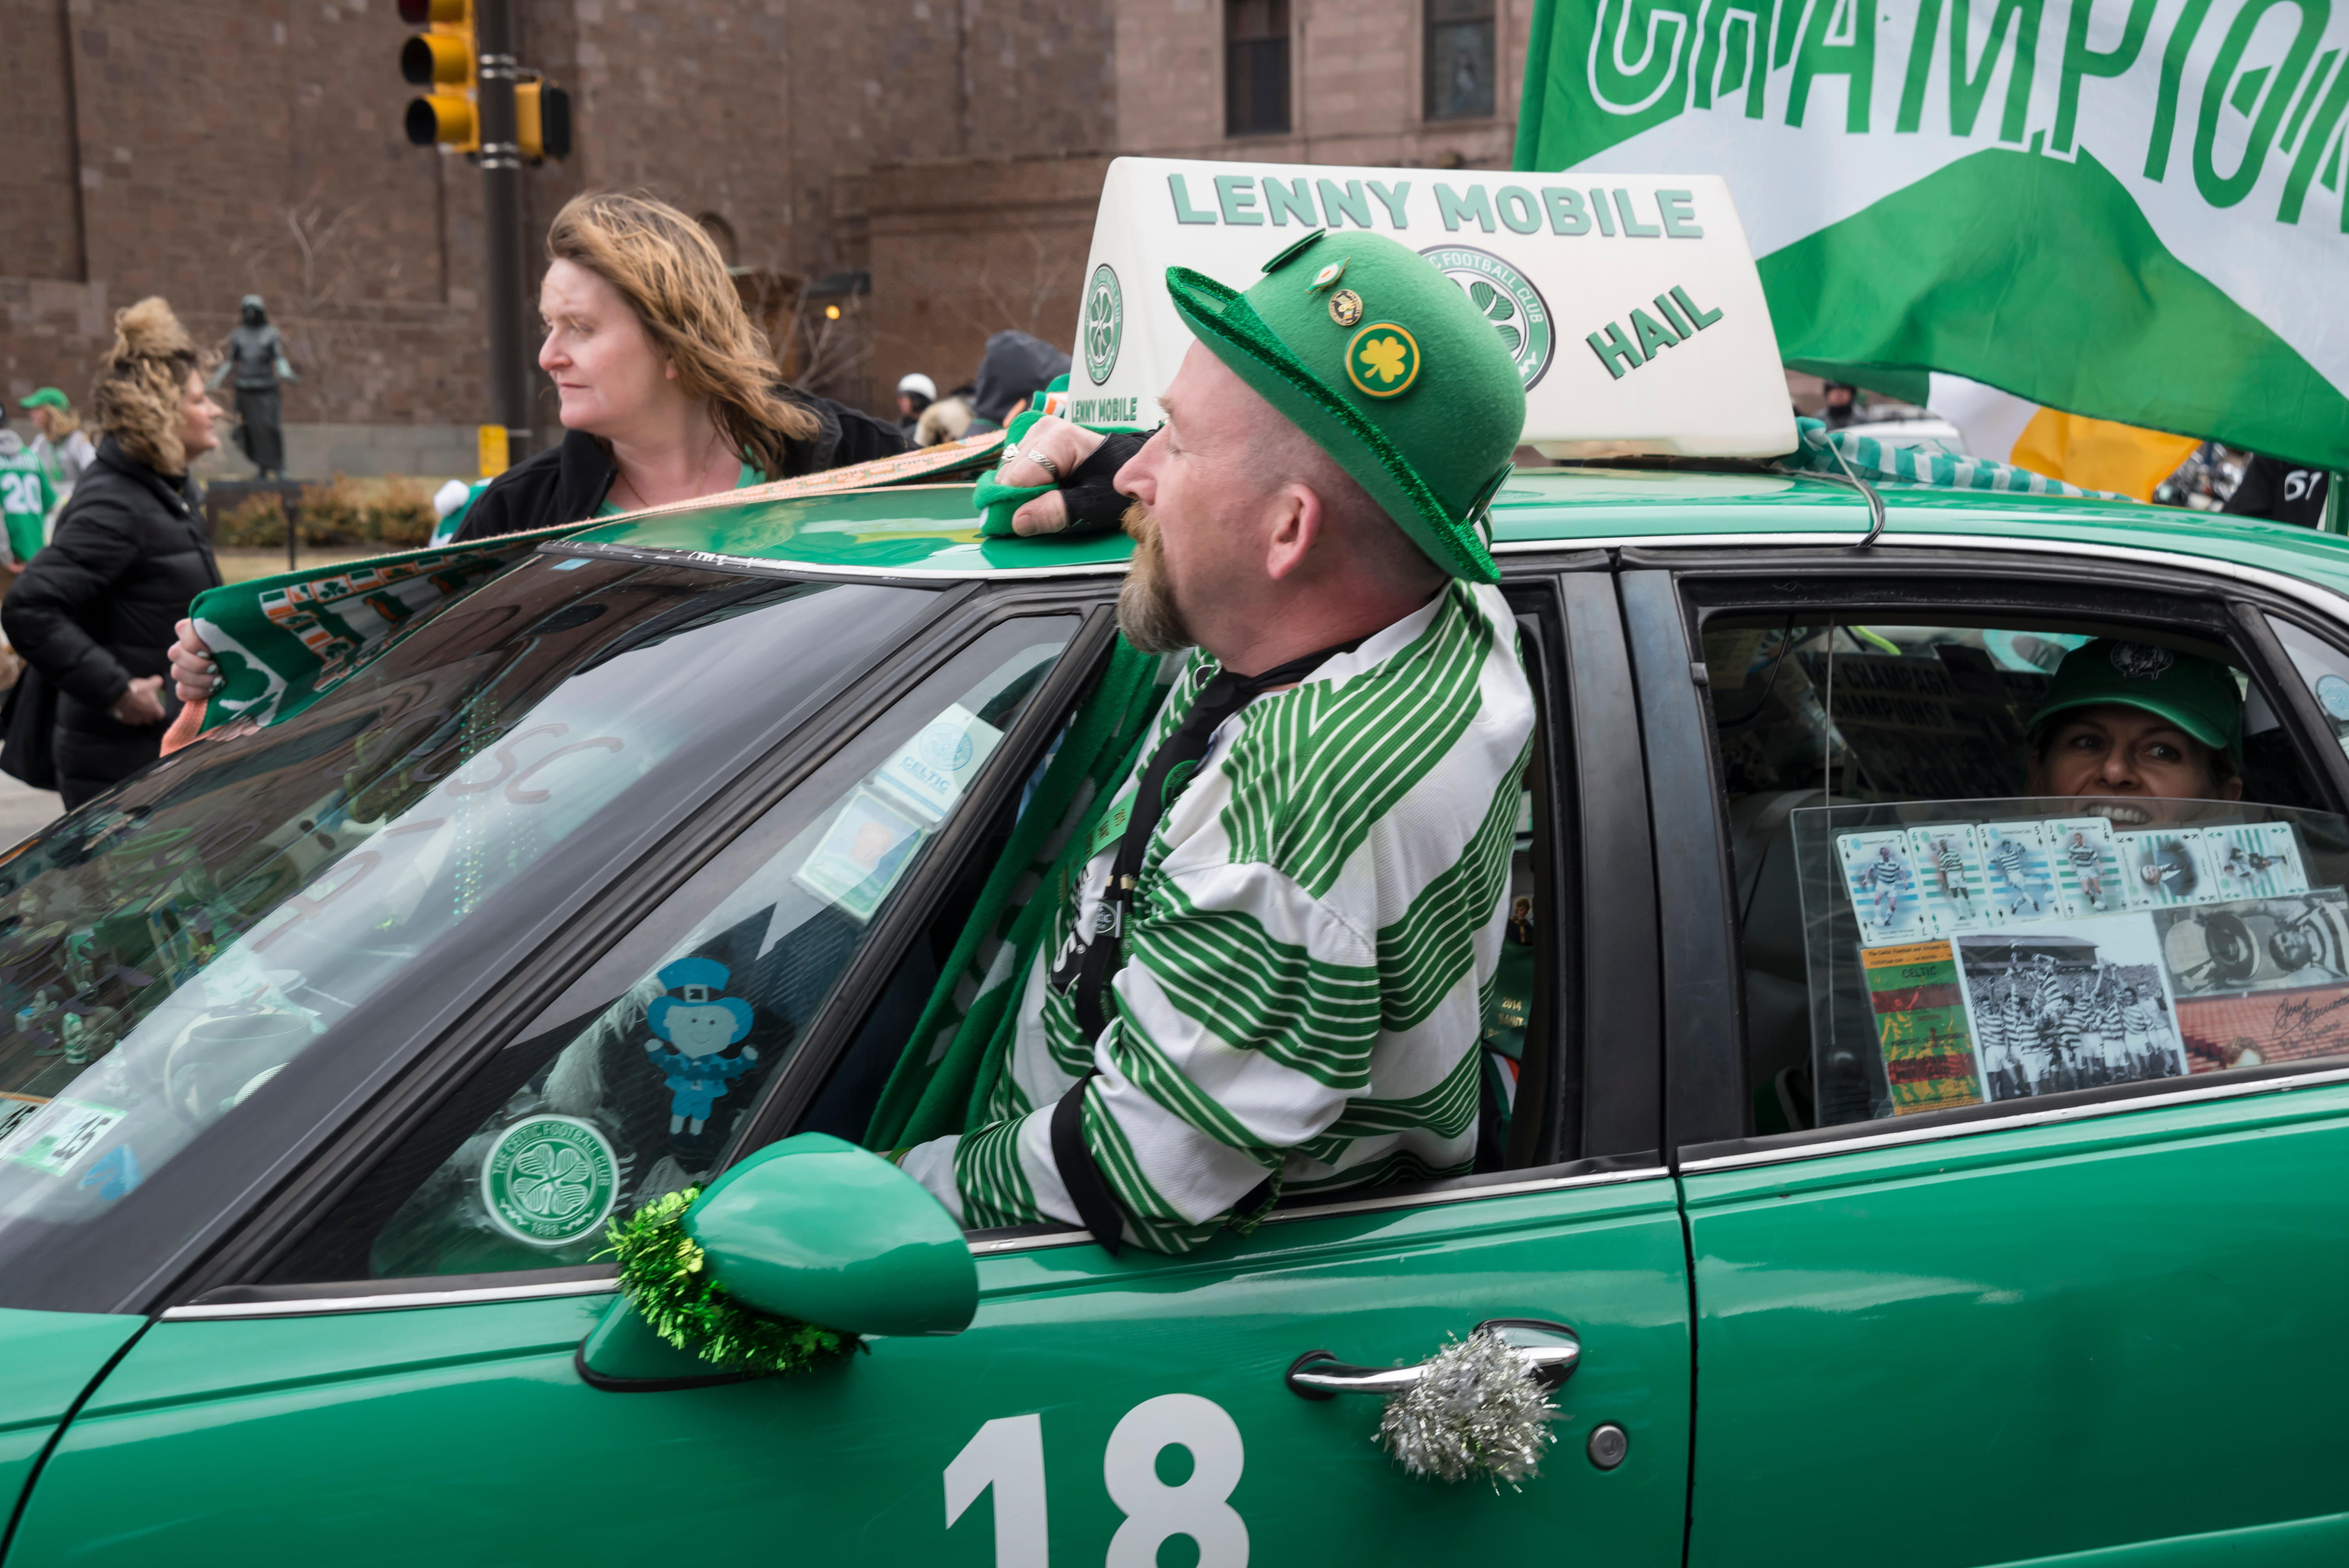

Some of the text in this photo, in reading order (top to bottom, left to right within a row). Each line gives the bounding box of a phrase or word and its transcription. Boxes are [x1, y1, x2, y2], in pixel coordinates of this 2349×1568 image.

[1168, 173, 1705, 239] LENNY MOBILE
[1442, 252, 1544, 324] FOOTBALL CLUB
[1585, 284, 1724, 380] HAIL
[1071, 396, 1138, 423] LENNY MOBILE
[0, 472, 42, 515] 20
[903, 756, 951, 790] CELTIC
[1902, 966, 1938, 979] CELTIC
[492, 1124, 612, 1187] THE CELTIC FOOTBALL CLUB
[943, 1392, 1249, 1568] 18
